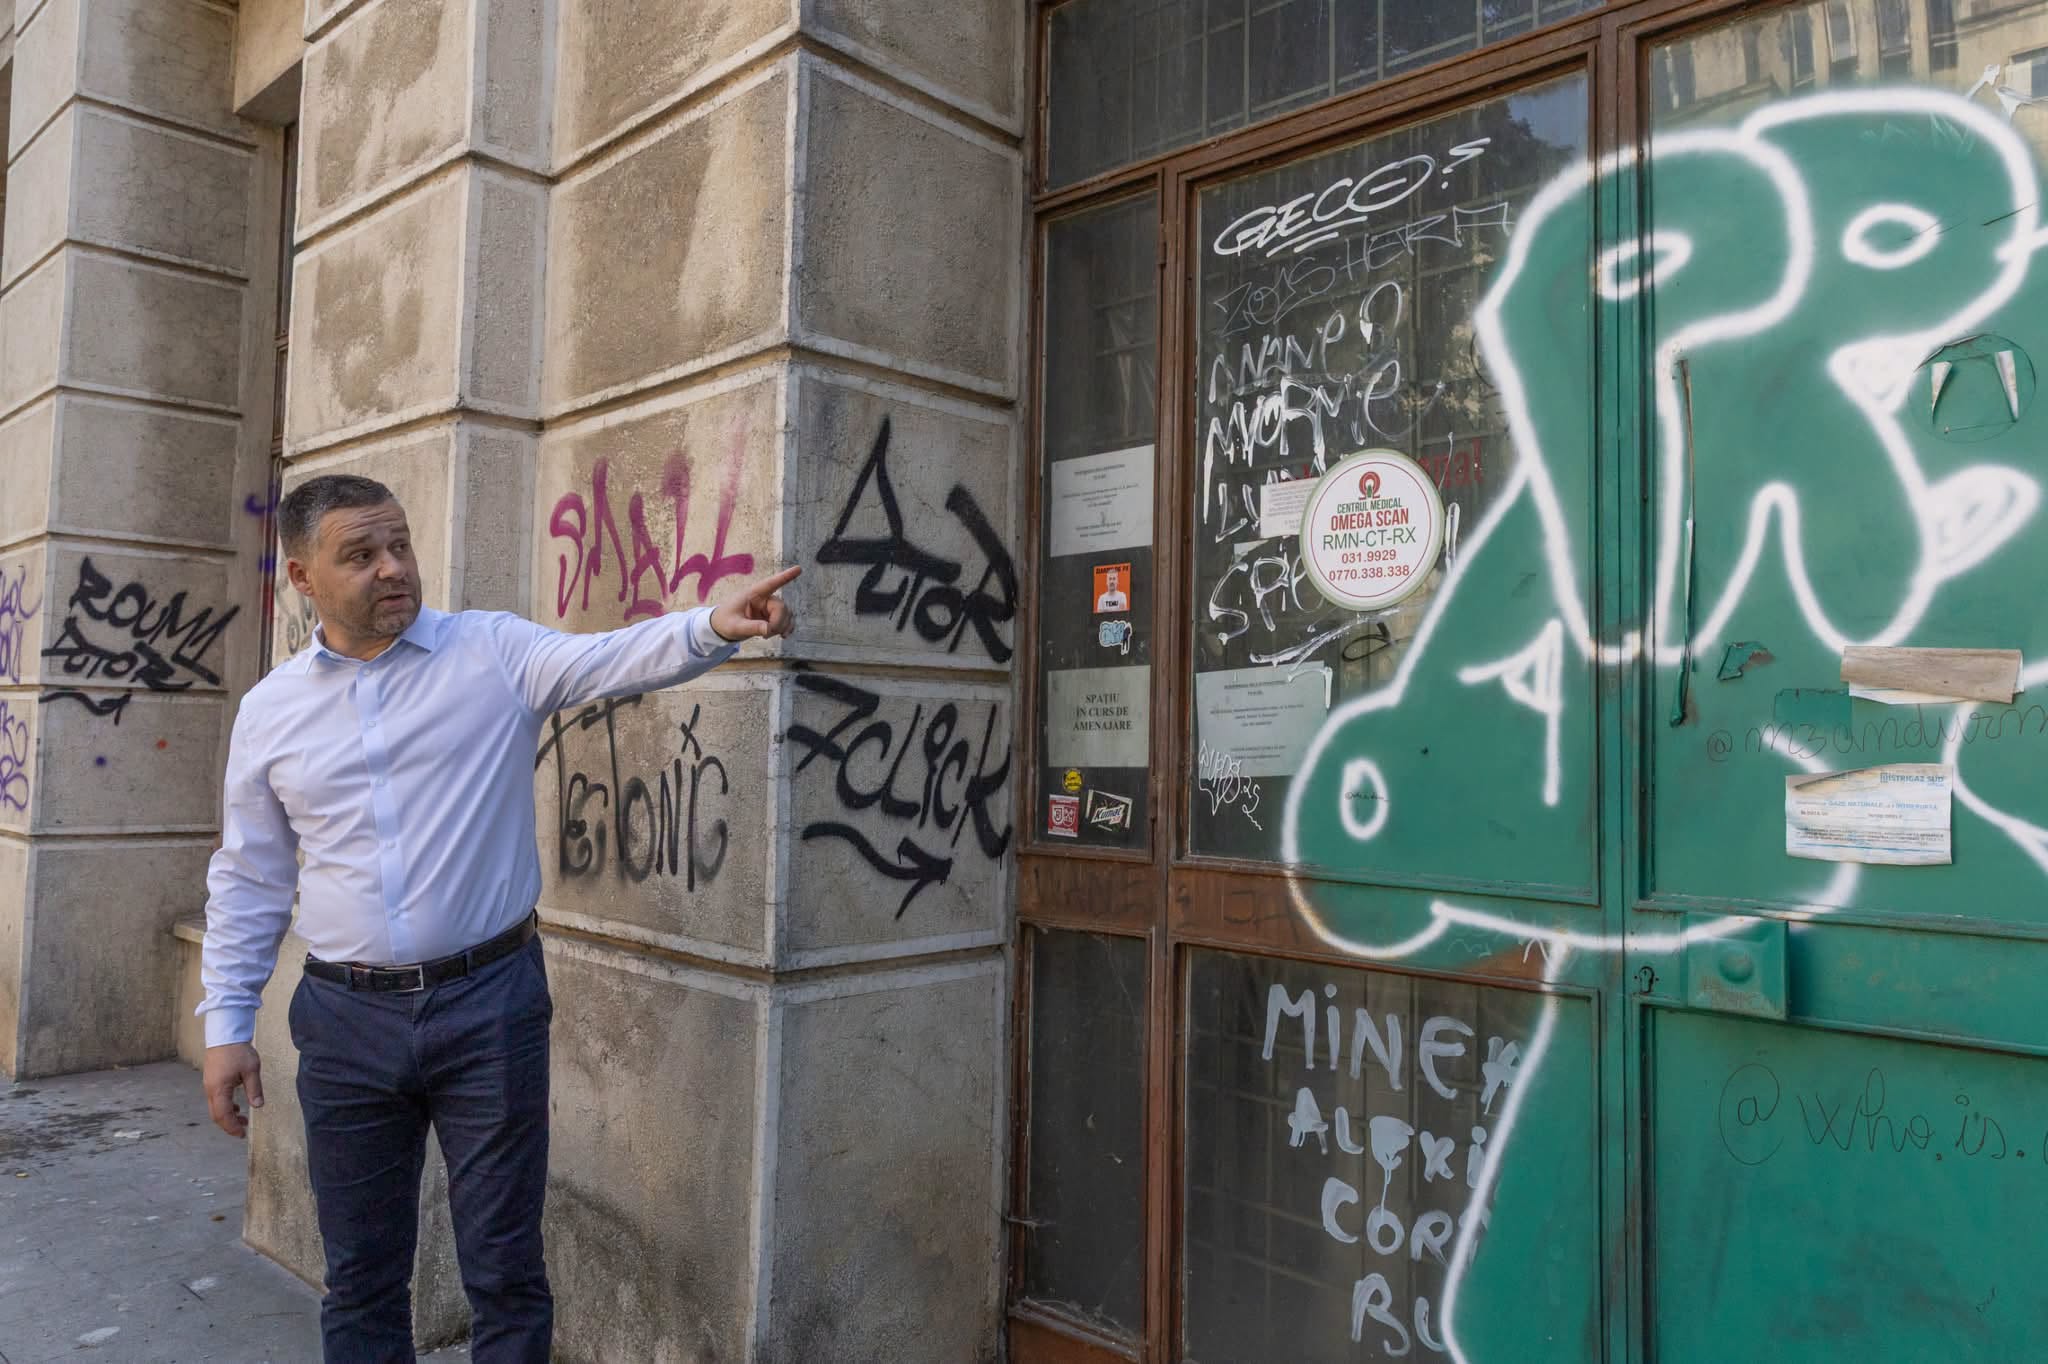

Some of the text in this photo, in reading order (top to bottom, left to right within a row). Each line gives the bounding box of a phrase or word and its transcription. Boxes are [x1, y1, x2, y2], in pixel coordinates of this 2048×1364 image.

[1337, 498, 1402, 514] CENTRUL MEDICAL
[1331, 508, 1409, 531] OMEGA SCAN
[1323, 526, 1416, 550] RMN-CT-RX
[1342, 549, 1397, 564] 031.9929
[1329, 565, 1410, 581] 0770.338.338
[1088, 707, 1115, 717] CURS
[1116, 706, 1129, 717] DE
[1072, 720, 1133, 731] AMENAJARE
